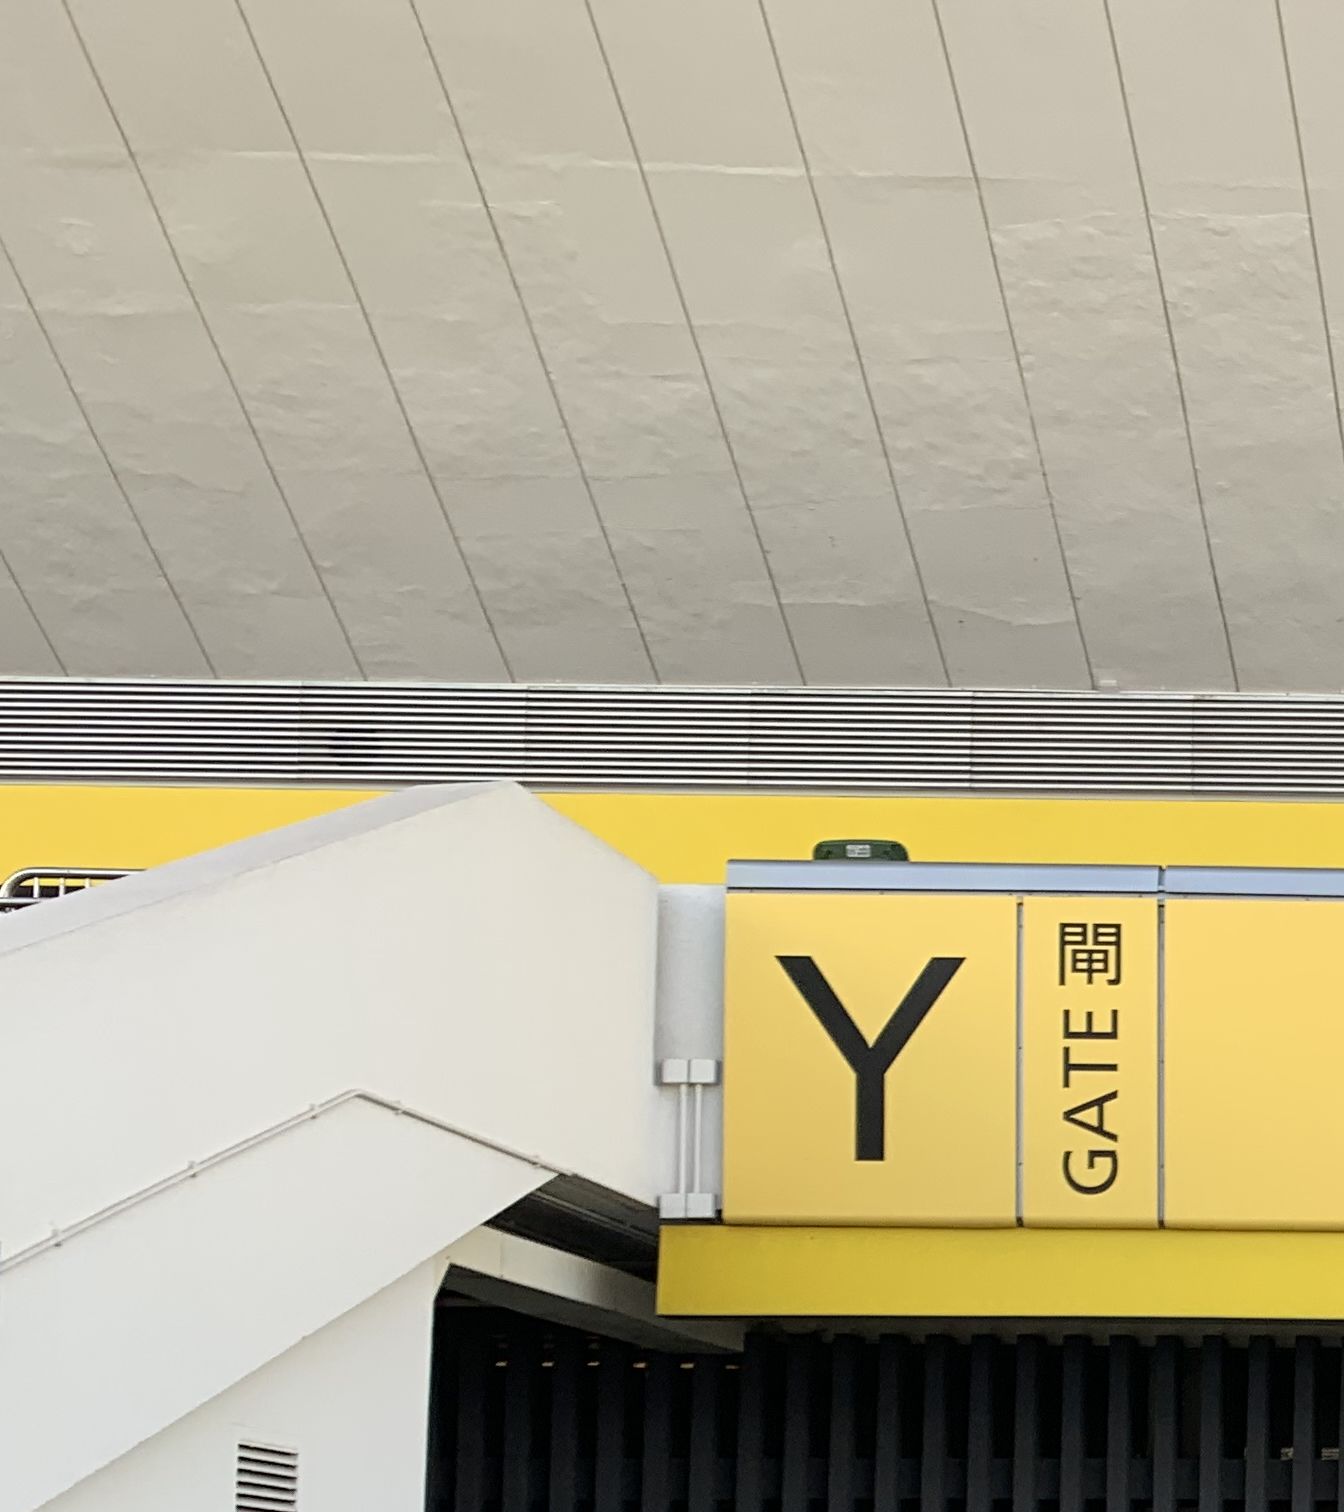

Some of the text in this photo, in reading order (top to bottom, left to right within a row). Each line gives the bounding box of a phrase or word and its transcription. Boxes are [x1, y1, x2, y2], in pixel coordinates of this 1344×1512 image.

[1058, 922, 1122, 986] 閘
[775, 955, 967, 1162] Y
[1062, 1008, 1119, 1196] GATE
